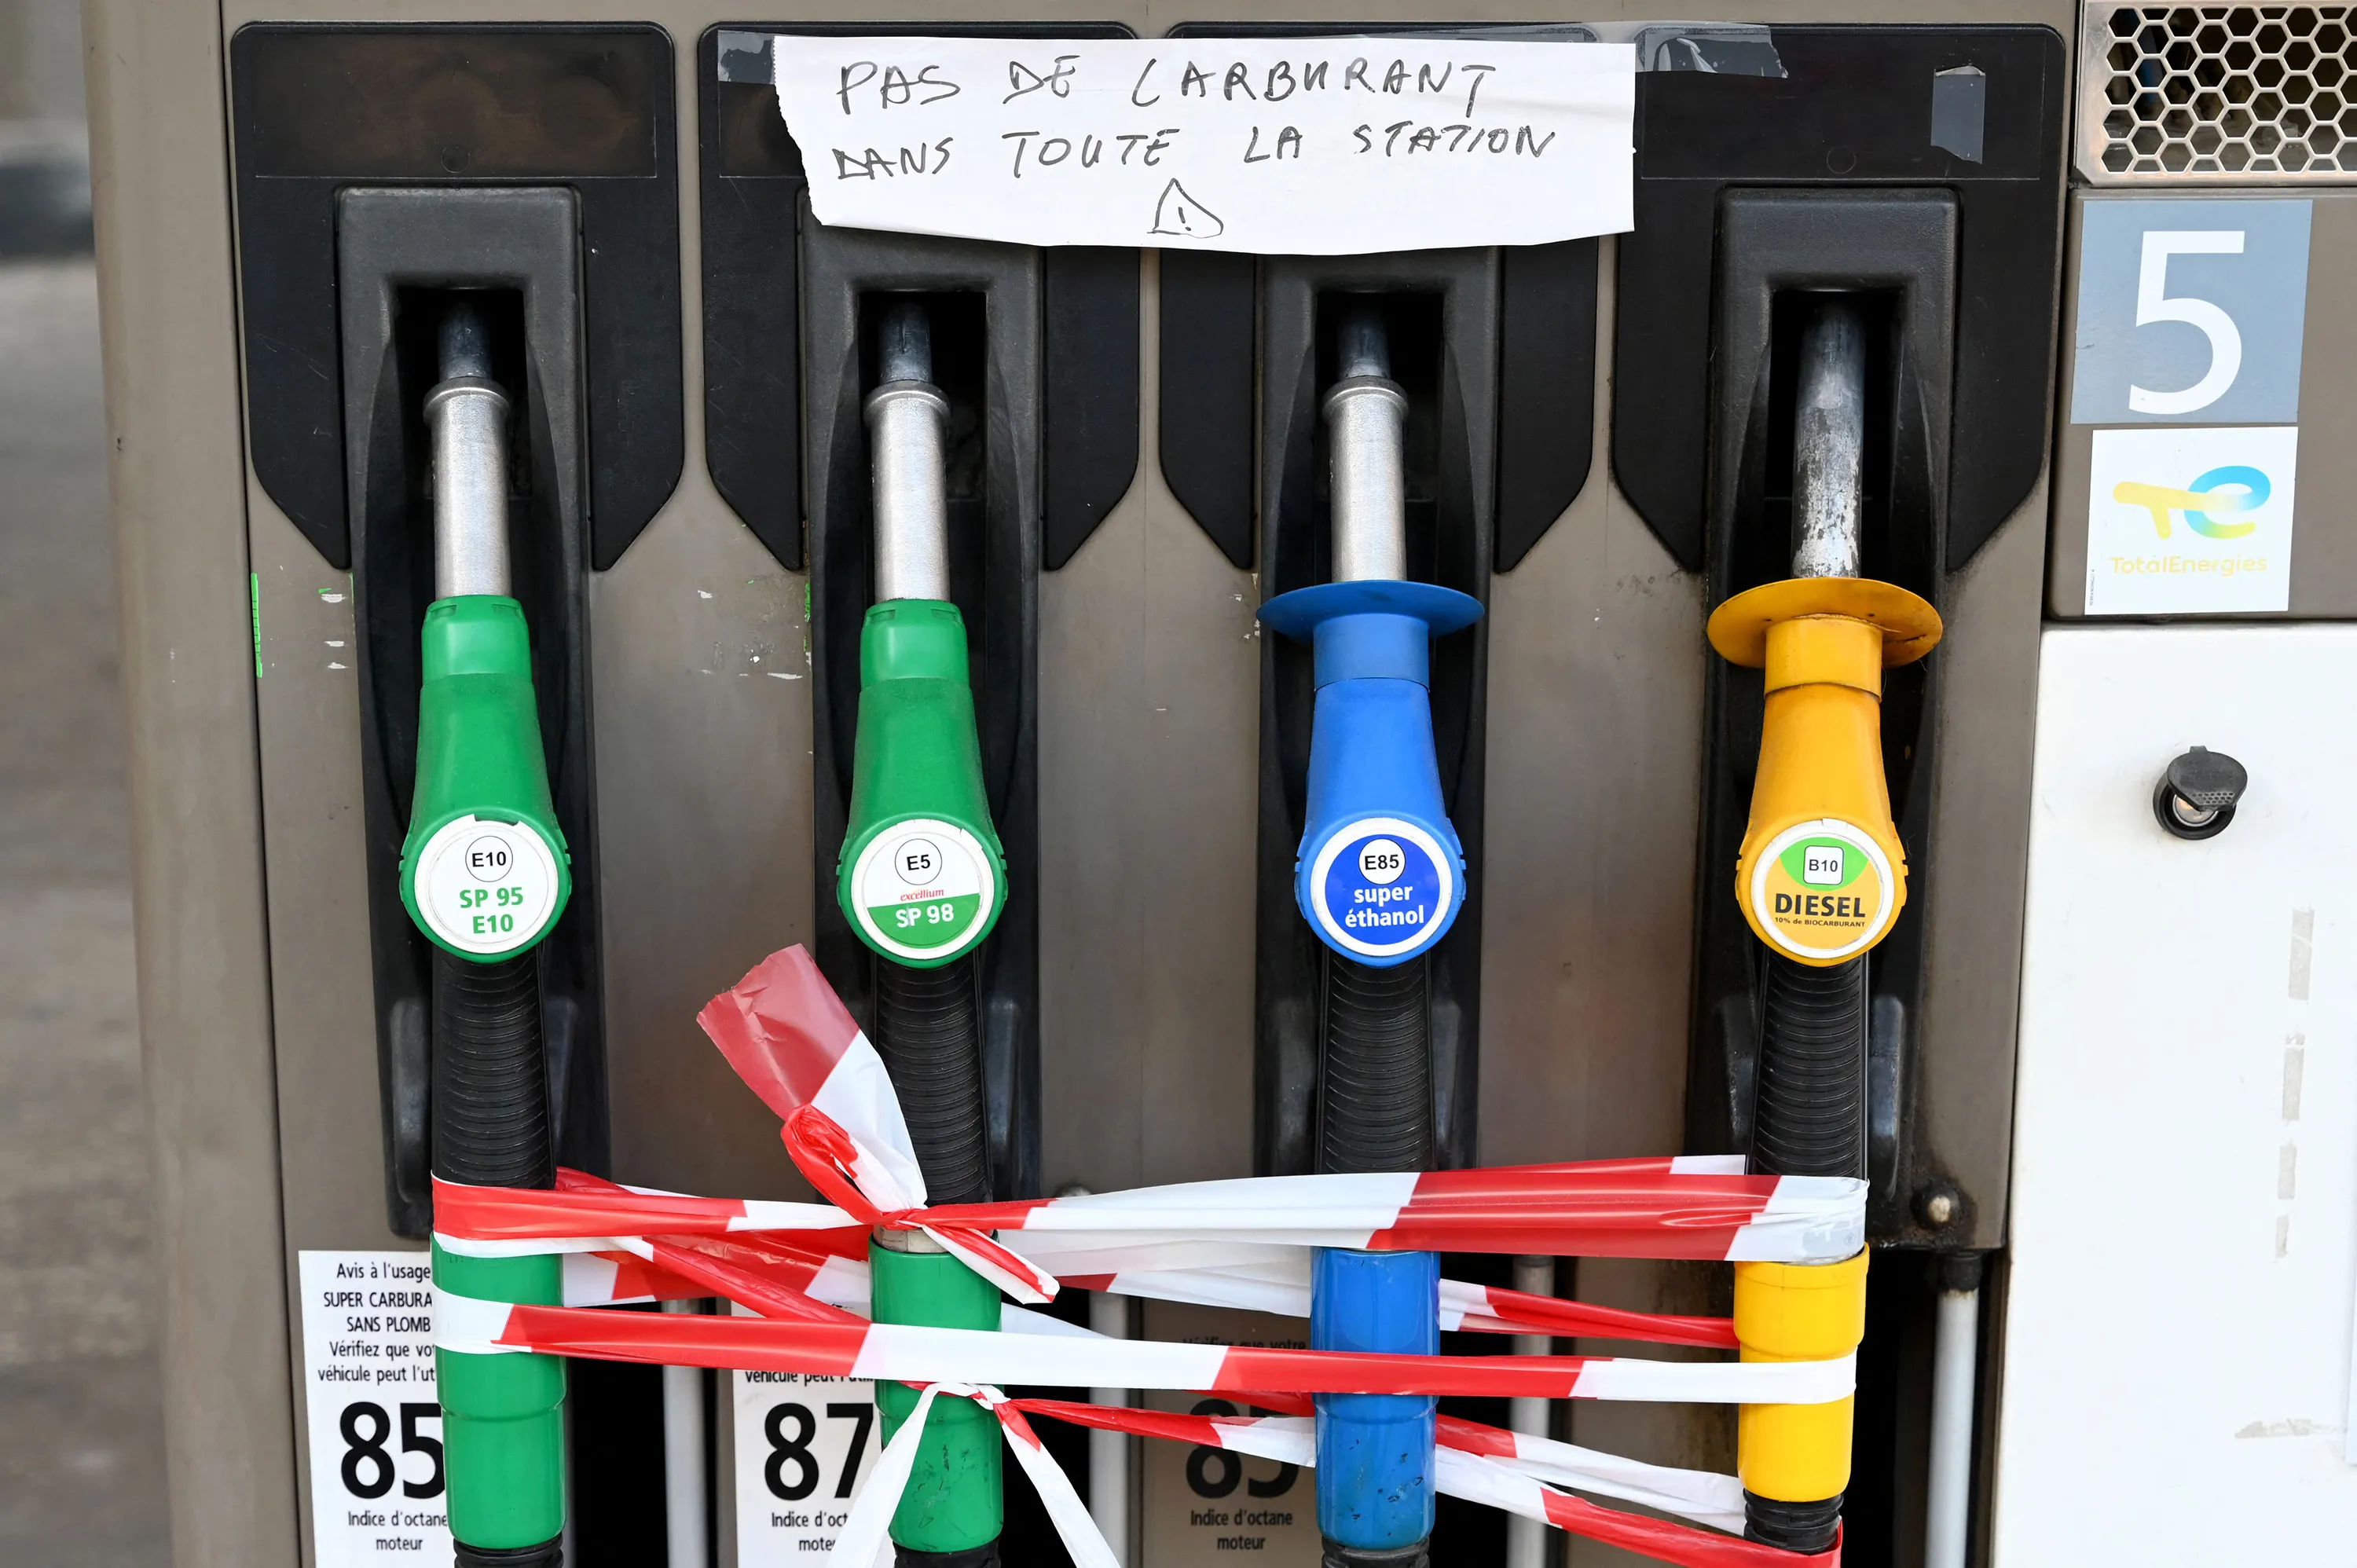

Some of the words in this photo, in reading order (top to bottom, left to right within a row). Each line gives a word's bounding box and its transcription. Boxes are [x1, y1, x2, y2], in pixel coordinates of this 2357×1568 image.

[837, 61, 961, 115] PAS
[1004, 55, 1081, 104] DE
[1131, 58, 1497, 119] CARBURANT
[832, 136, 954, 181] DANS
[1000, 127, 1182, 179] TOUTE
[1243, 126, 1303, 164] LA
[1352, 121, 1557, 159] STATION
[2128, 230, 2245, 415] 5
[2110, 555, 2267, 577] TotalEnergies
[471, 851, 507, 867] E10
[906, 854, 931, 871] E5
[1364, 854, 1399, 870] E85
[1809, 859, 1838, 872] B10
[460, 888, 489, 909] SP
[497, 887, 524, 907] 95
[900, 888, 944, 902] excellium
[1354, 885, 1413, 907] super
[1775, 892, 1866, 918] DIESEL
[472, 914, 514, 934] E10
[896, 907, 922, 928] SP
[926, 903, 955, 924] 98
[1345, 904, 1424, 928] éthanol
[1804, 919, 1866, 928] BIOCARBURANT
[336, 1262, 365, 1279] Avis
[370, 1261, 378, 1279] à
[383, 1261, 431, 1284] l'usage
[324, 1291, 364, 1308] SUPER
[368, 1291, 433, 1308] CARBURA
[346, 1317, 381, 1332] SANS
[387, 1317, 431, 1332] PLOMB
[329, 1339, 379, 1357] Vérifiez
[385, 1344, 409, 1361] que
[317, 1364, 371, 1382] véhicule
[376, 1366, 407, 1387] peut
[412, 1364, 436, 1382] l'ut
[339, 1401, 445, 1499] 85
[764, 1402, 874, 1501] 87
[348, 1510, 386, 1526] Indice
[391, 1510, 447, 1526] d'octane
[772, 1510, 808, 1527] Indice
[815, 1510, 849, 1527] d'oct
[1190, 1508, 1229, 1526] Indice
[1233, 1508, 1293, 1526] d'octane
[376, 1537, 423, 1551] moteur
[798, 1537, 836, 1551] mote
[1217, 1535, 1266, 1550] moteur
